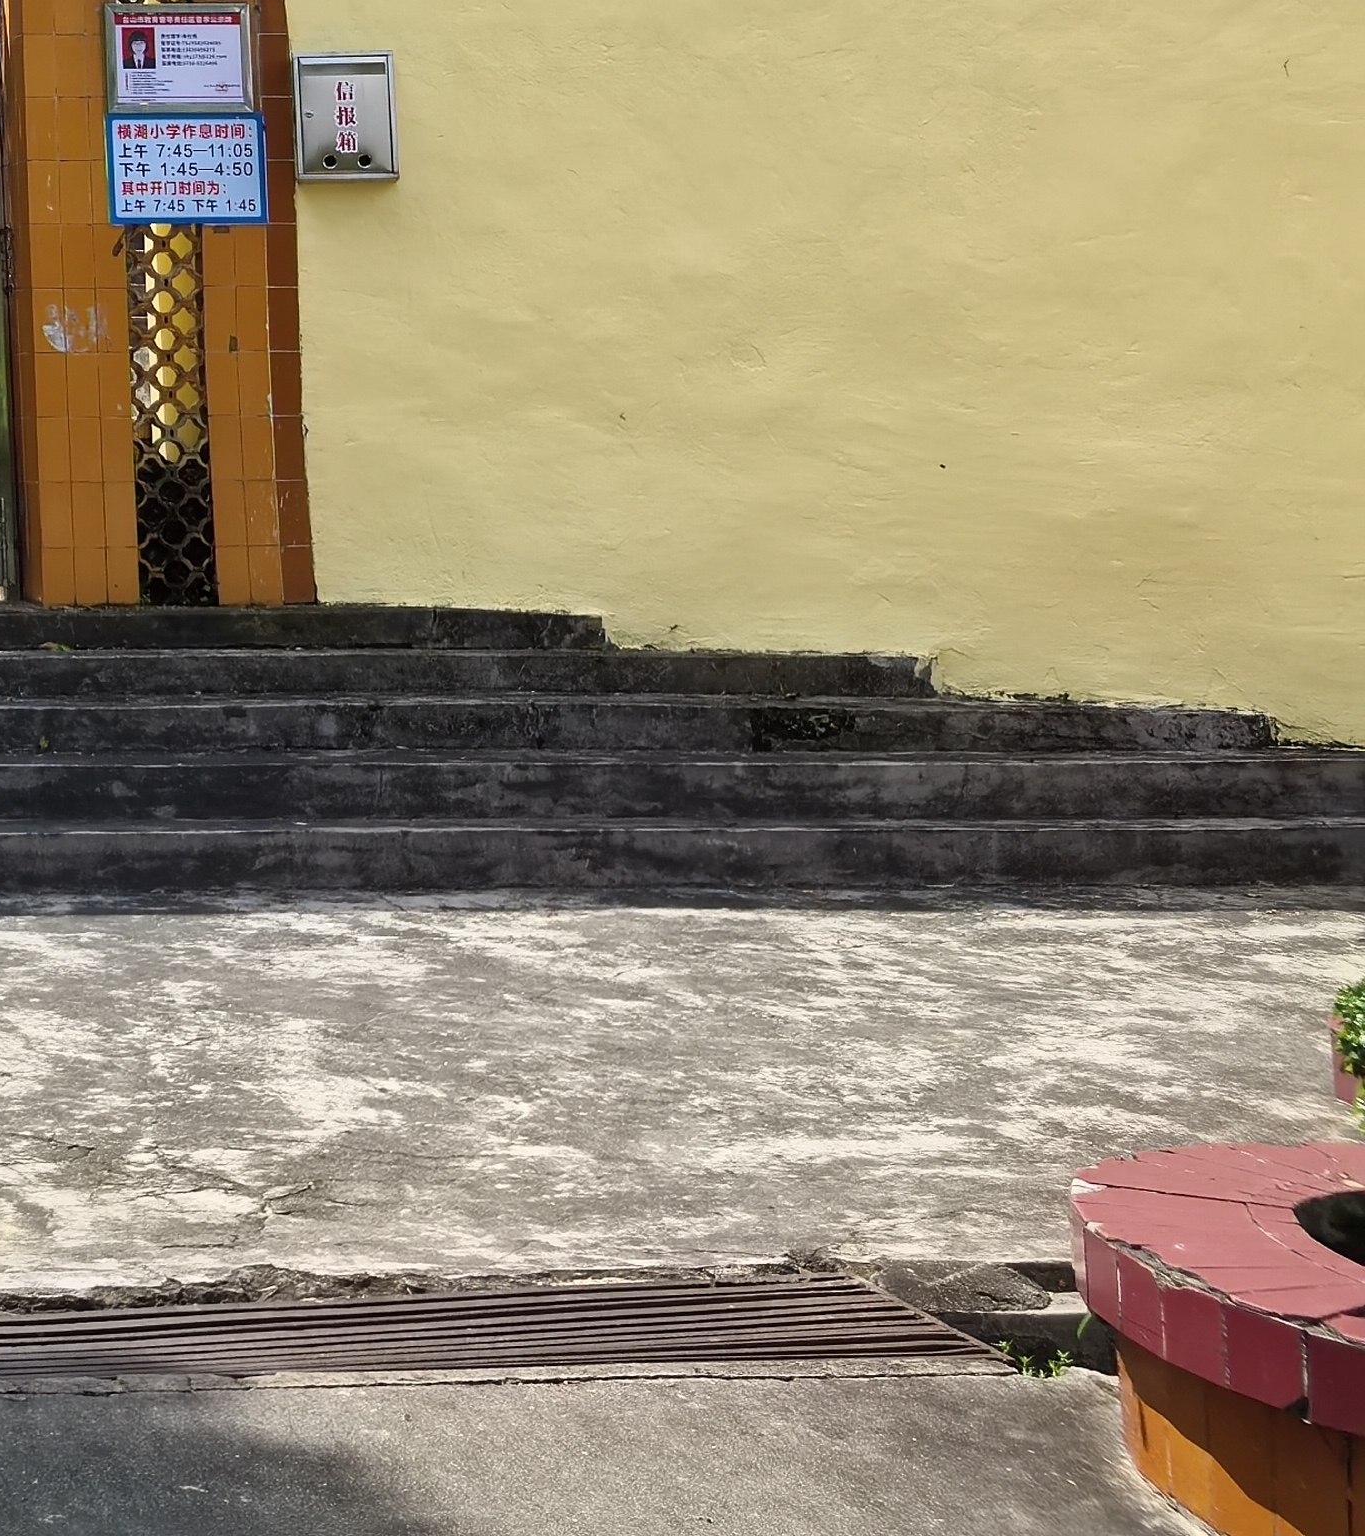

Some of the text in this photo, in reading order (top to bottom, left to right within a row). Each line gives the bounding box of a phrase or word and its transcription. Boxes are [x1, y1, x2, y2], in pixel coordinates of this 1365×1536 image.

[334, 81, 358, 153] 信报箱
[119, 143, 148, 158] 上午
[119, 162, 151, 177] 下午
[121, 199, 256, 212] 上午 7:45 下午 1:45
